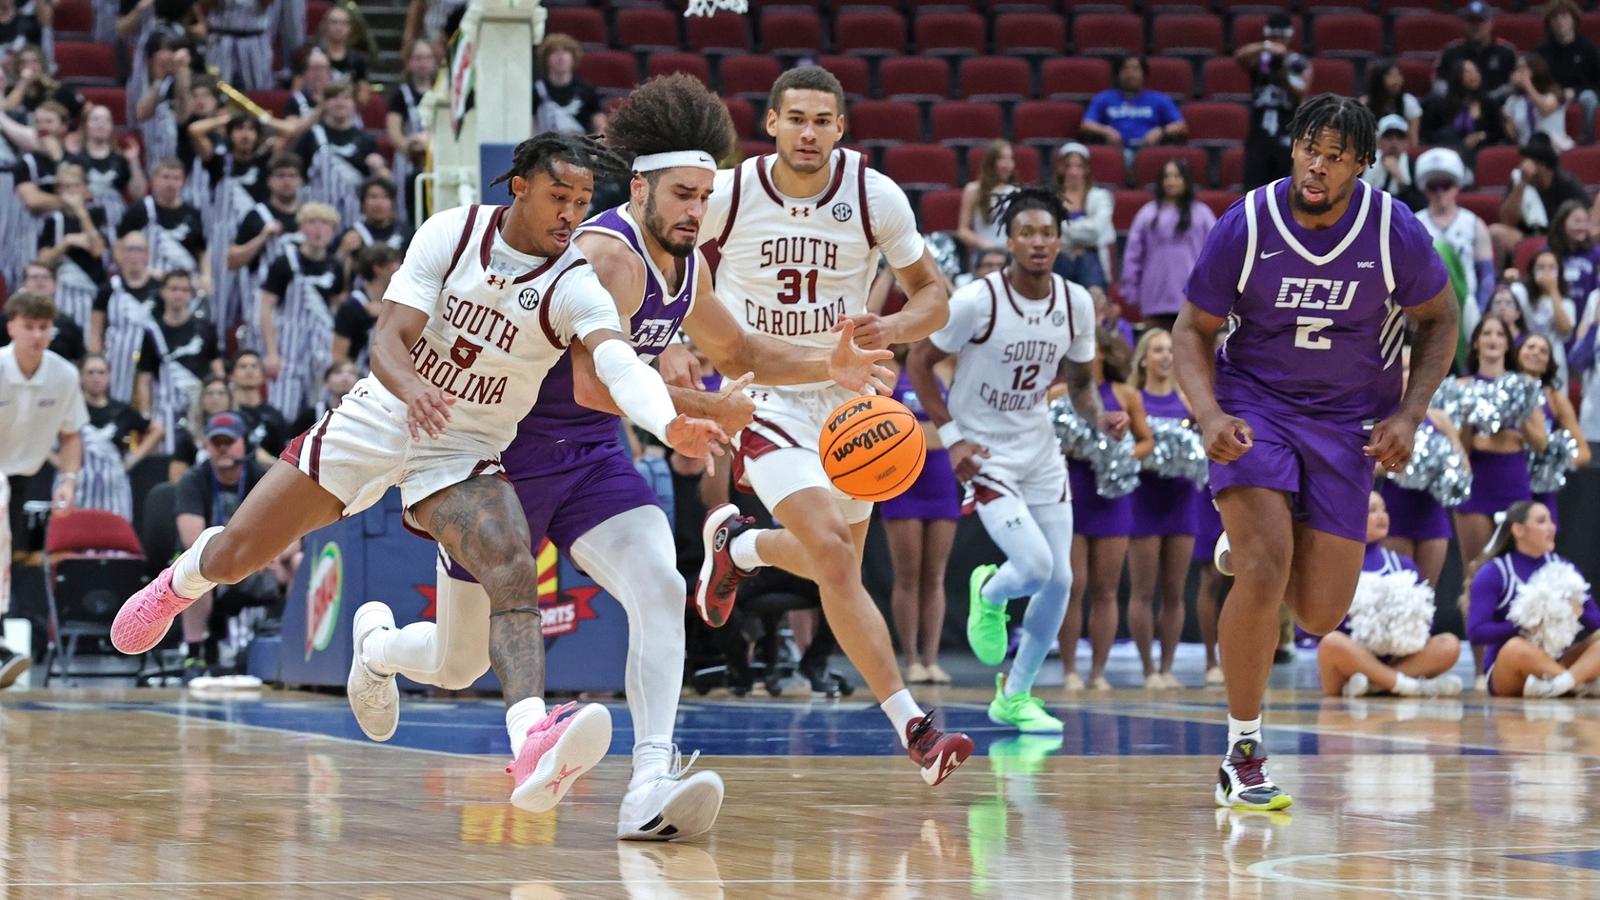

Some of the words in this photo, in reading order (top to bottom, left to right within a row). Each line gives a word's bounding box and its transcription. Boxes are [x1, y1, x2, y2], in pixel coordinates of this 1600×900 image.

[760, 236, 838, 270] SOUTH
[1356, 261, 1375, 269] WAC
[519, 288, 539, 310] SEC
[777, 268, 818, 304] 31
[1274, 277, 1360, 310] GCU
[442, 294, 519, 353] SOUTH
[1294, 316, 1334, 350] 2
[1001, 340, 1057, 364] SOUTH
[409, 336, 508, 405] AROLINA
[1011, 364, 1040, 391] 12
[828, 401, 872, 433] NCAA
[832, 419, 901, 462] Wilson
